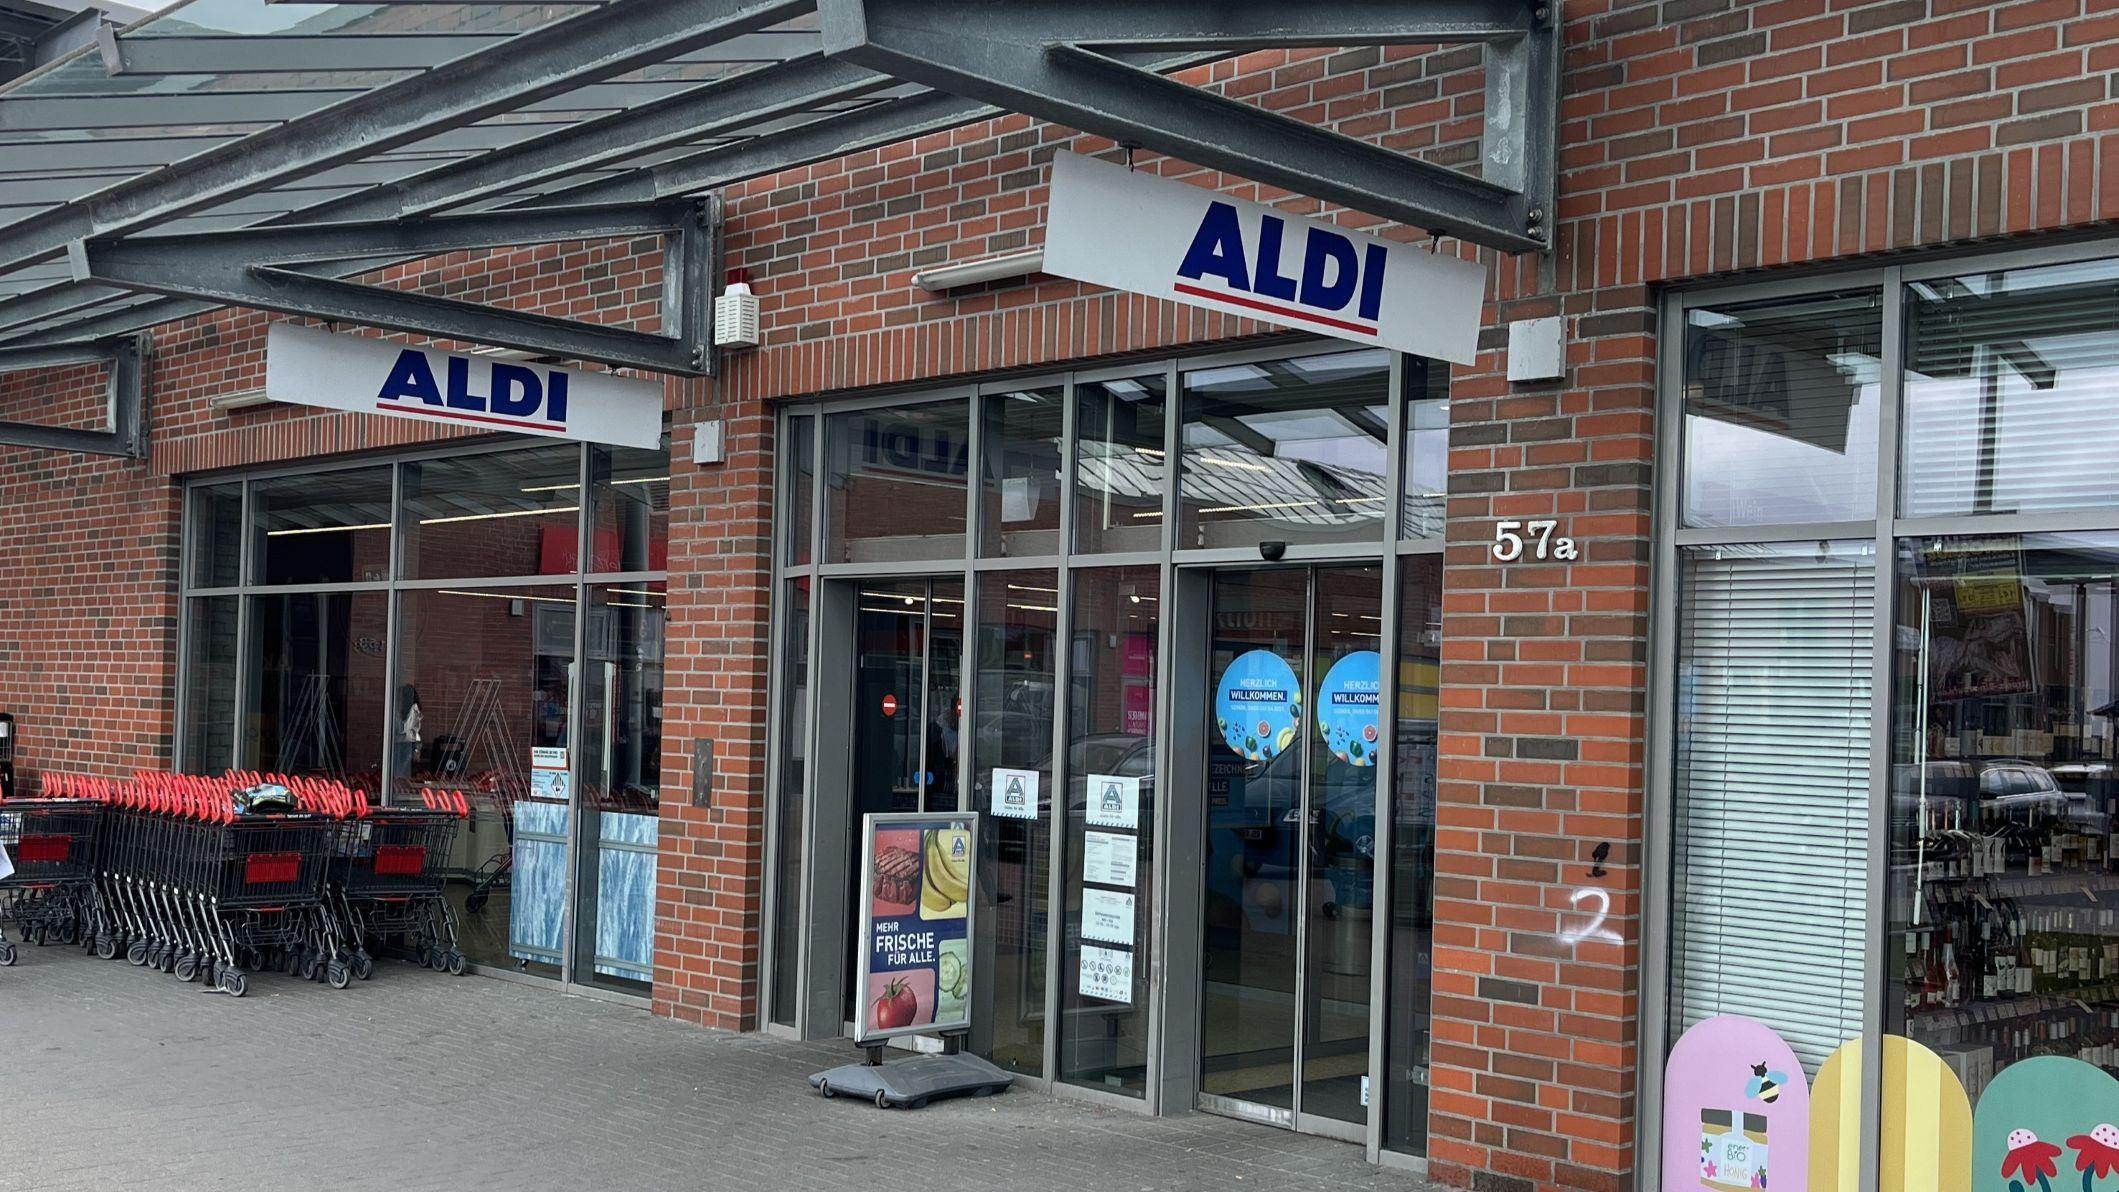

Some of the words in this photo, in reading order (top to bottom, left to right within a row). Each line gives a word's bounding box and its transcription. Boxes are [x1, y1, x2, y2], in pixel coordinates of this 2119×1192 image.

[1176, 200, 1388, 321] ALDI
[377, 348, 569, 423] ALDI
[1491, 520, 1579, 562] 57a
[1240, 679, 1277, 688] HERZLICH
[1344, 681, 1379, 691] HERZLIC
[1231, 690, 1286, 701] WILLKOMMEN.
[876, 921, 899, 933] MEHR
[876, 932, 935, 953] FRISCHE
[887, 950, 907, 966] FÜR
[909, 951, 936, 964] ALLE.
[1723, 1163, 1749, 1180] HONIG
